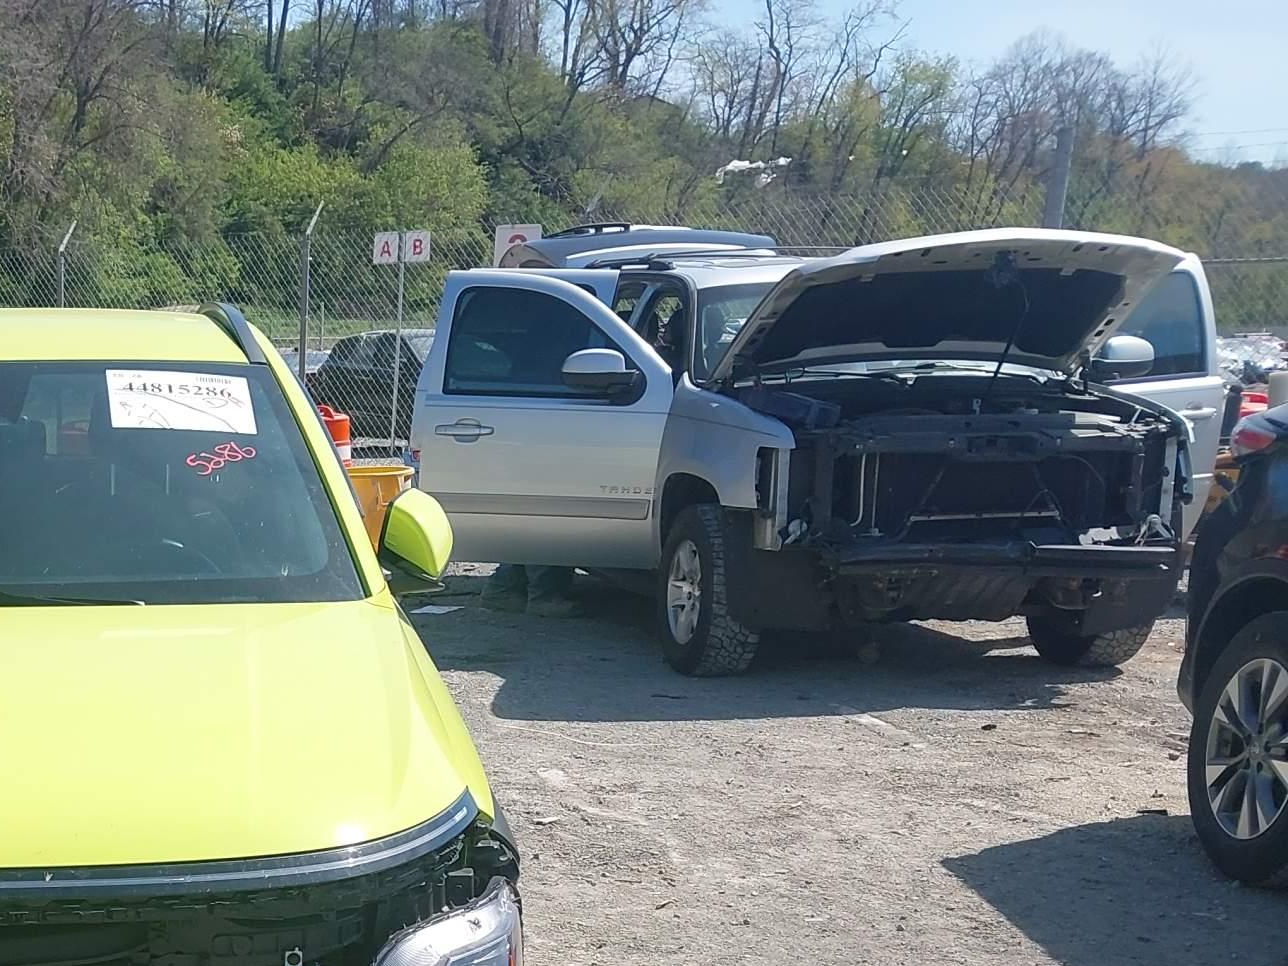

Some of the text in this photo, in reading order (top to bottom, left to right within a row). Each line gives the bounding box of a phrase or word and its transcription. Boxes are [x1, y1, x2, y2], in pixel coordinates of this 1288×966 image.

[379, 240, 392, 257] A
[412, 238, 423, 255] B
[122, 381, 232, 399] 44815286
